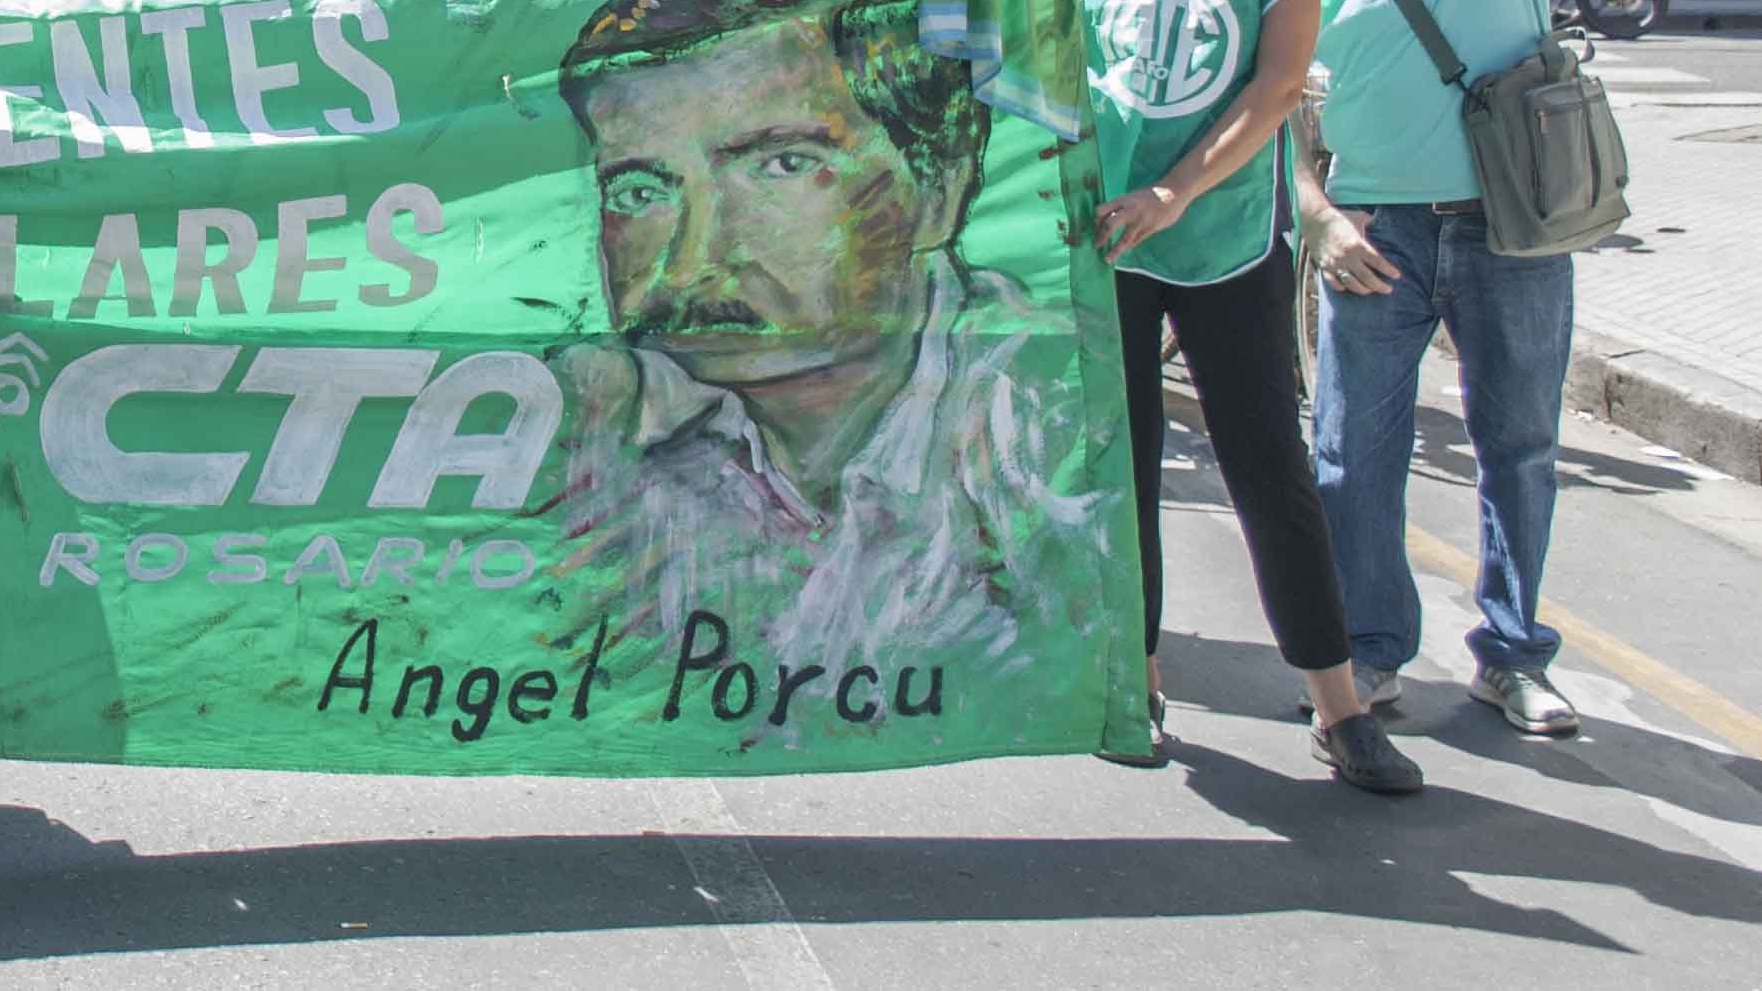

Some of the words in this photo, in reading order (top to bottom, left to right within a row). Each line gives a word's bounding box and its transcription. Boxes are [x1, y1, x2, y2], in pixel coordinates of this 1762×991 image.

[39, 344, 565, 507] CTA
[39, 532, 538, 590] ROSARIO
[319, 614, 609, 742] Angel
[661, 609, 944, 725] Porcu
